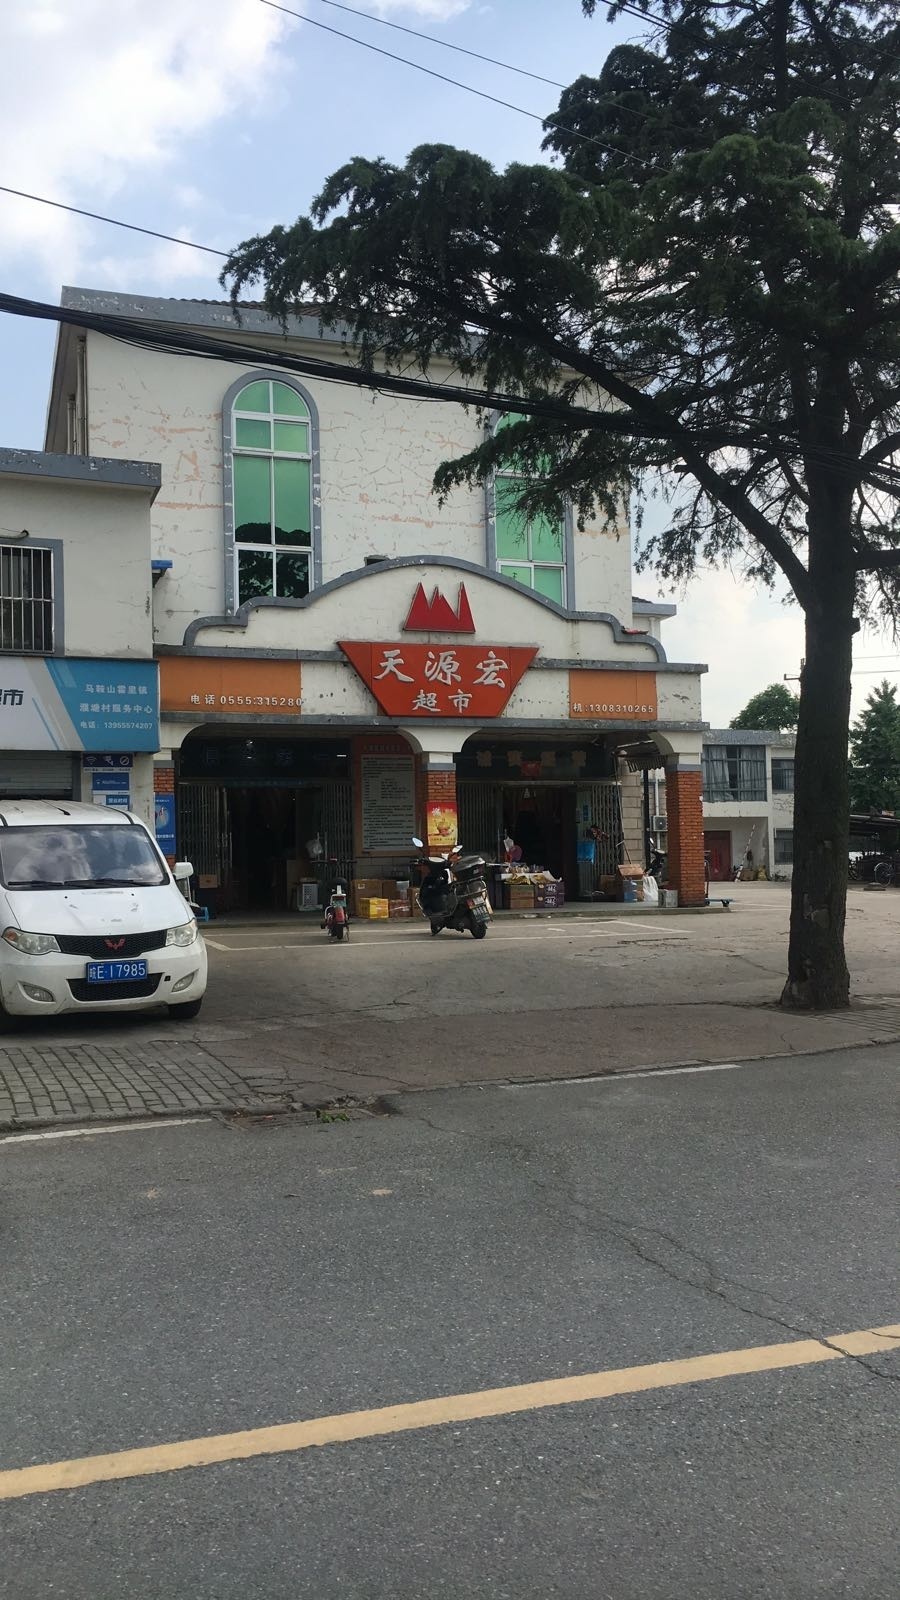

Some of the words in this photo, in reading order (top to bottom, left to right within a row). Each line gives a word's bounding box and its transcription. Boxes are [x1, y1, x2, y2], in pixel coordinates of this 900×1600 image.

[373, 649, 509, 688] 天源宏
[0, 689, 24, 706] 市
[190, 694, 216, 705] 电话
[412, 689, 473, 713] 超市
